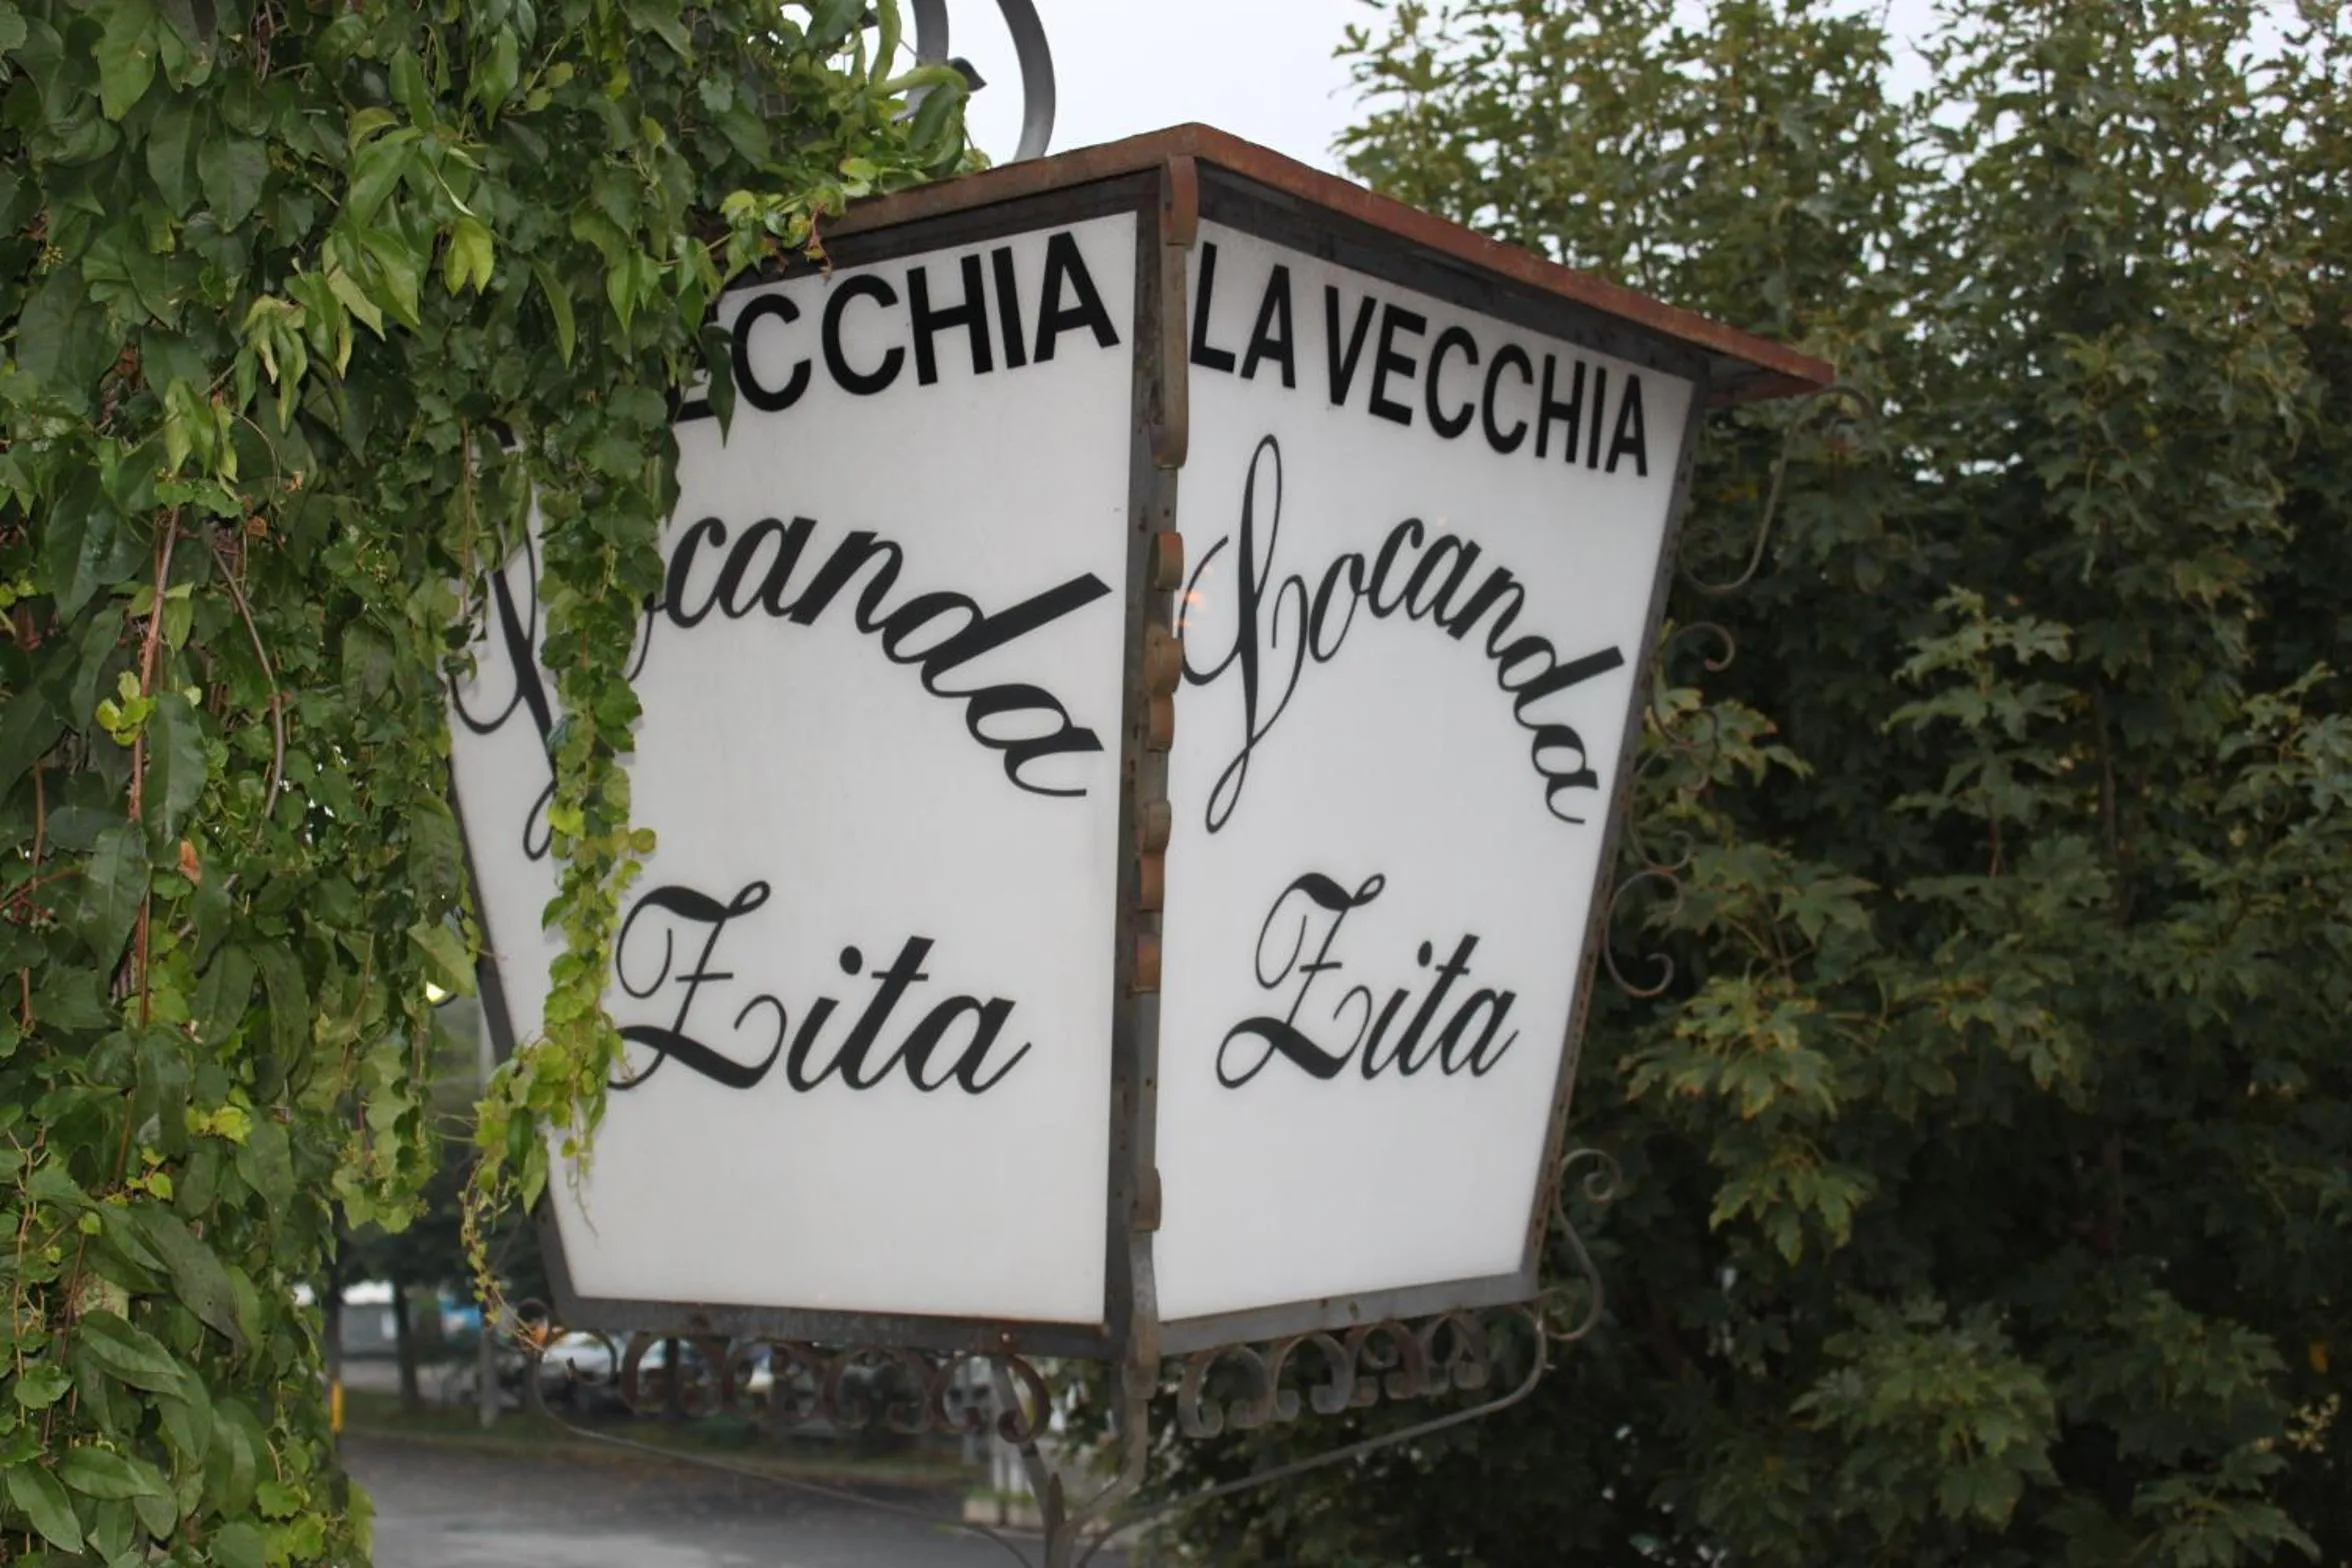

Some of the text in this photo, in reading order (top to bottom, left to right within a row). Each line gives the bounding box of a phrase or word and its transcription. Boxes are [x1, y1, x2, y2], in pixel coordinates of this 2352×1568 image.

[1190, 243, 1648, 477] LA VECCHIA
[450, 516, 1112, 861] Lcanda
[1178, 434, 1625, 833] Locanda
[607, 880, 1031, 1093] Zita
[1217, 872, 1519, 1089] Zita
